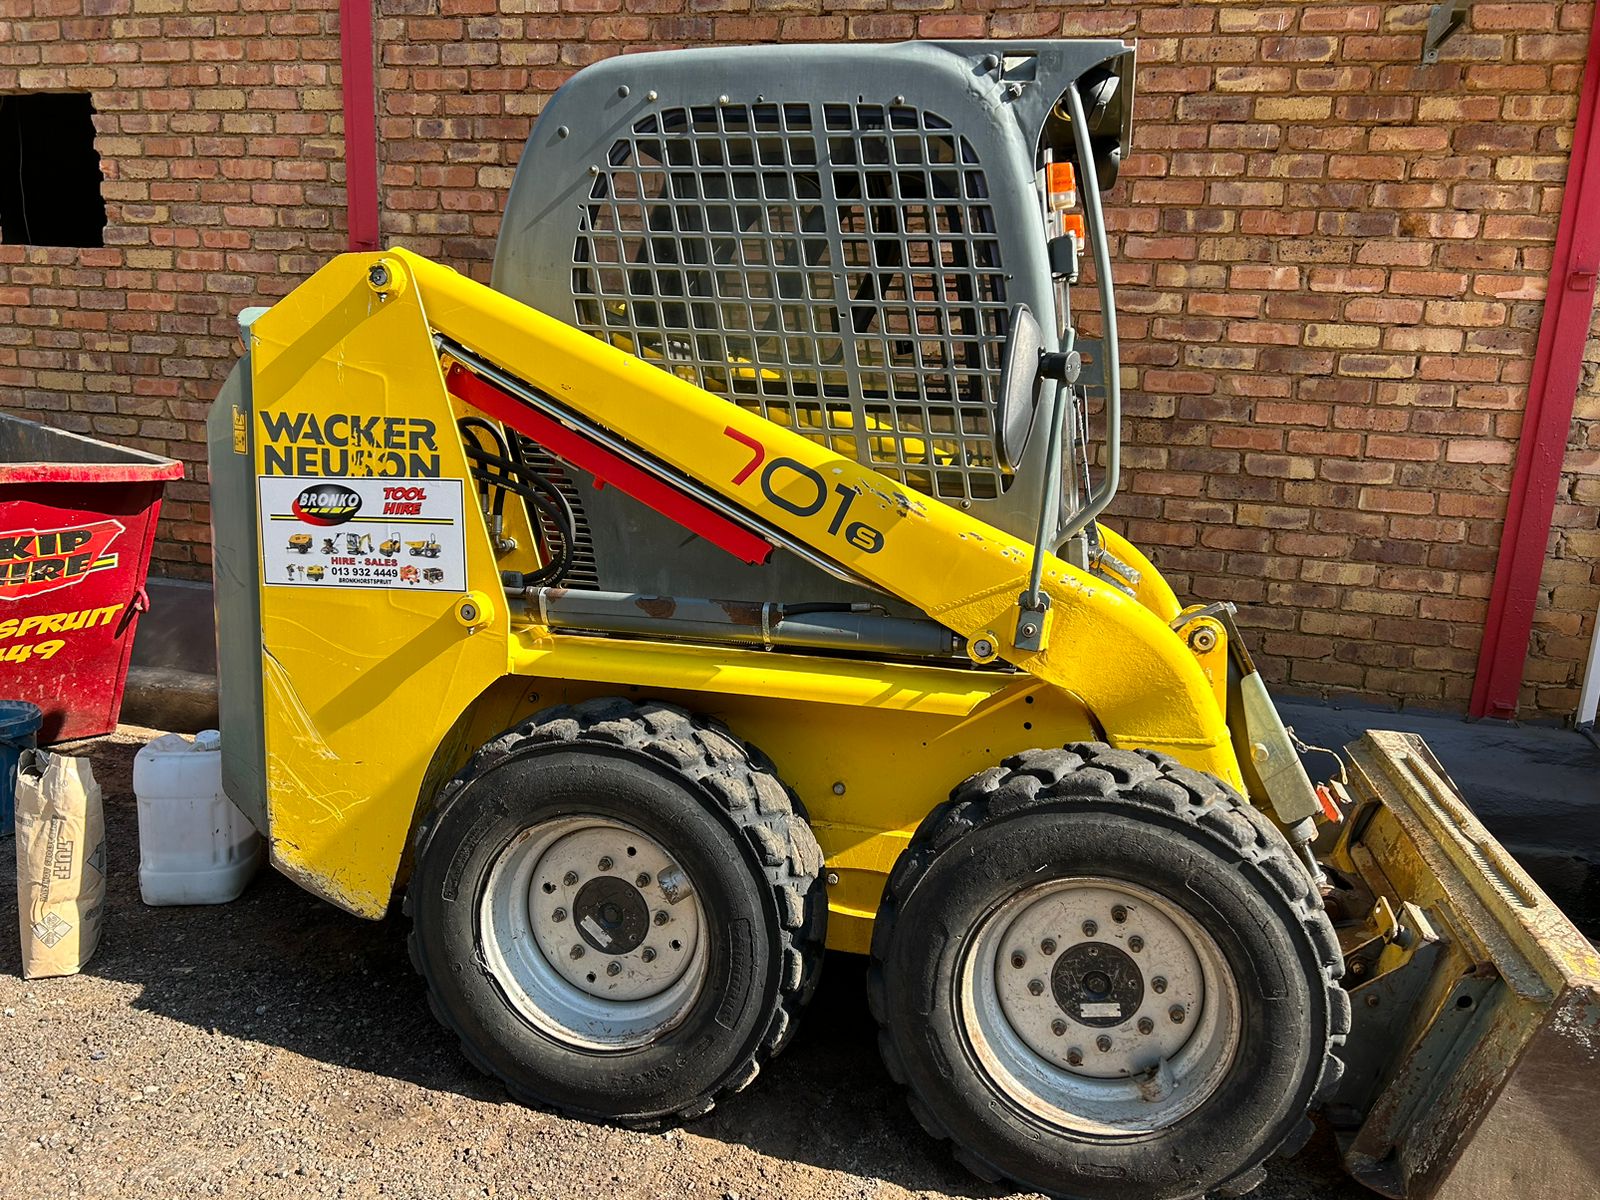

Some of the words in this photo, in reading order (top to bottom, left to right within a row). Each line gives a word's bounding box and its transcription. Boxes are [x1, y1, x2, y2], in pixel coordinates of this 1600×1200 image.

[259, 411, 438, 451] WACKER
[300, 493, 360, 507] BRONKO
[383, 487, 427, 500] TOOL
[383, 502, 422, 516] HIRE
[331, 557, 356, 566] HIRE
[364, 558, 398, 567] SALES
[331, 567, 350, 576] 013
[352, 568, 371, 577] 932
[373, 568, 398, 578] 4449
[338, 577, 392, 585] BRONKHORSTSPRUIT
[0, 639, 66, 664] 49
[53, 840, 74, 879] TUFF
